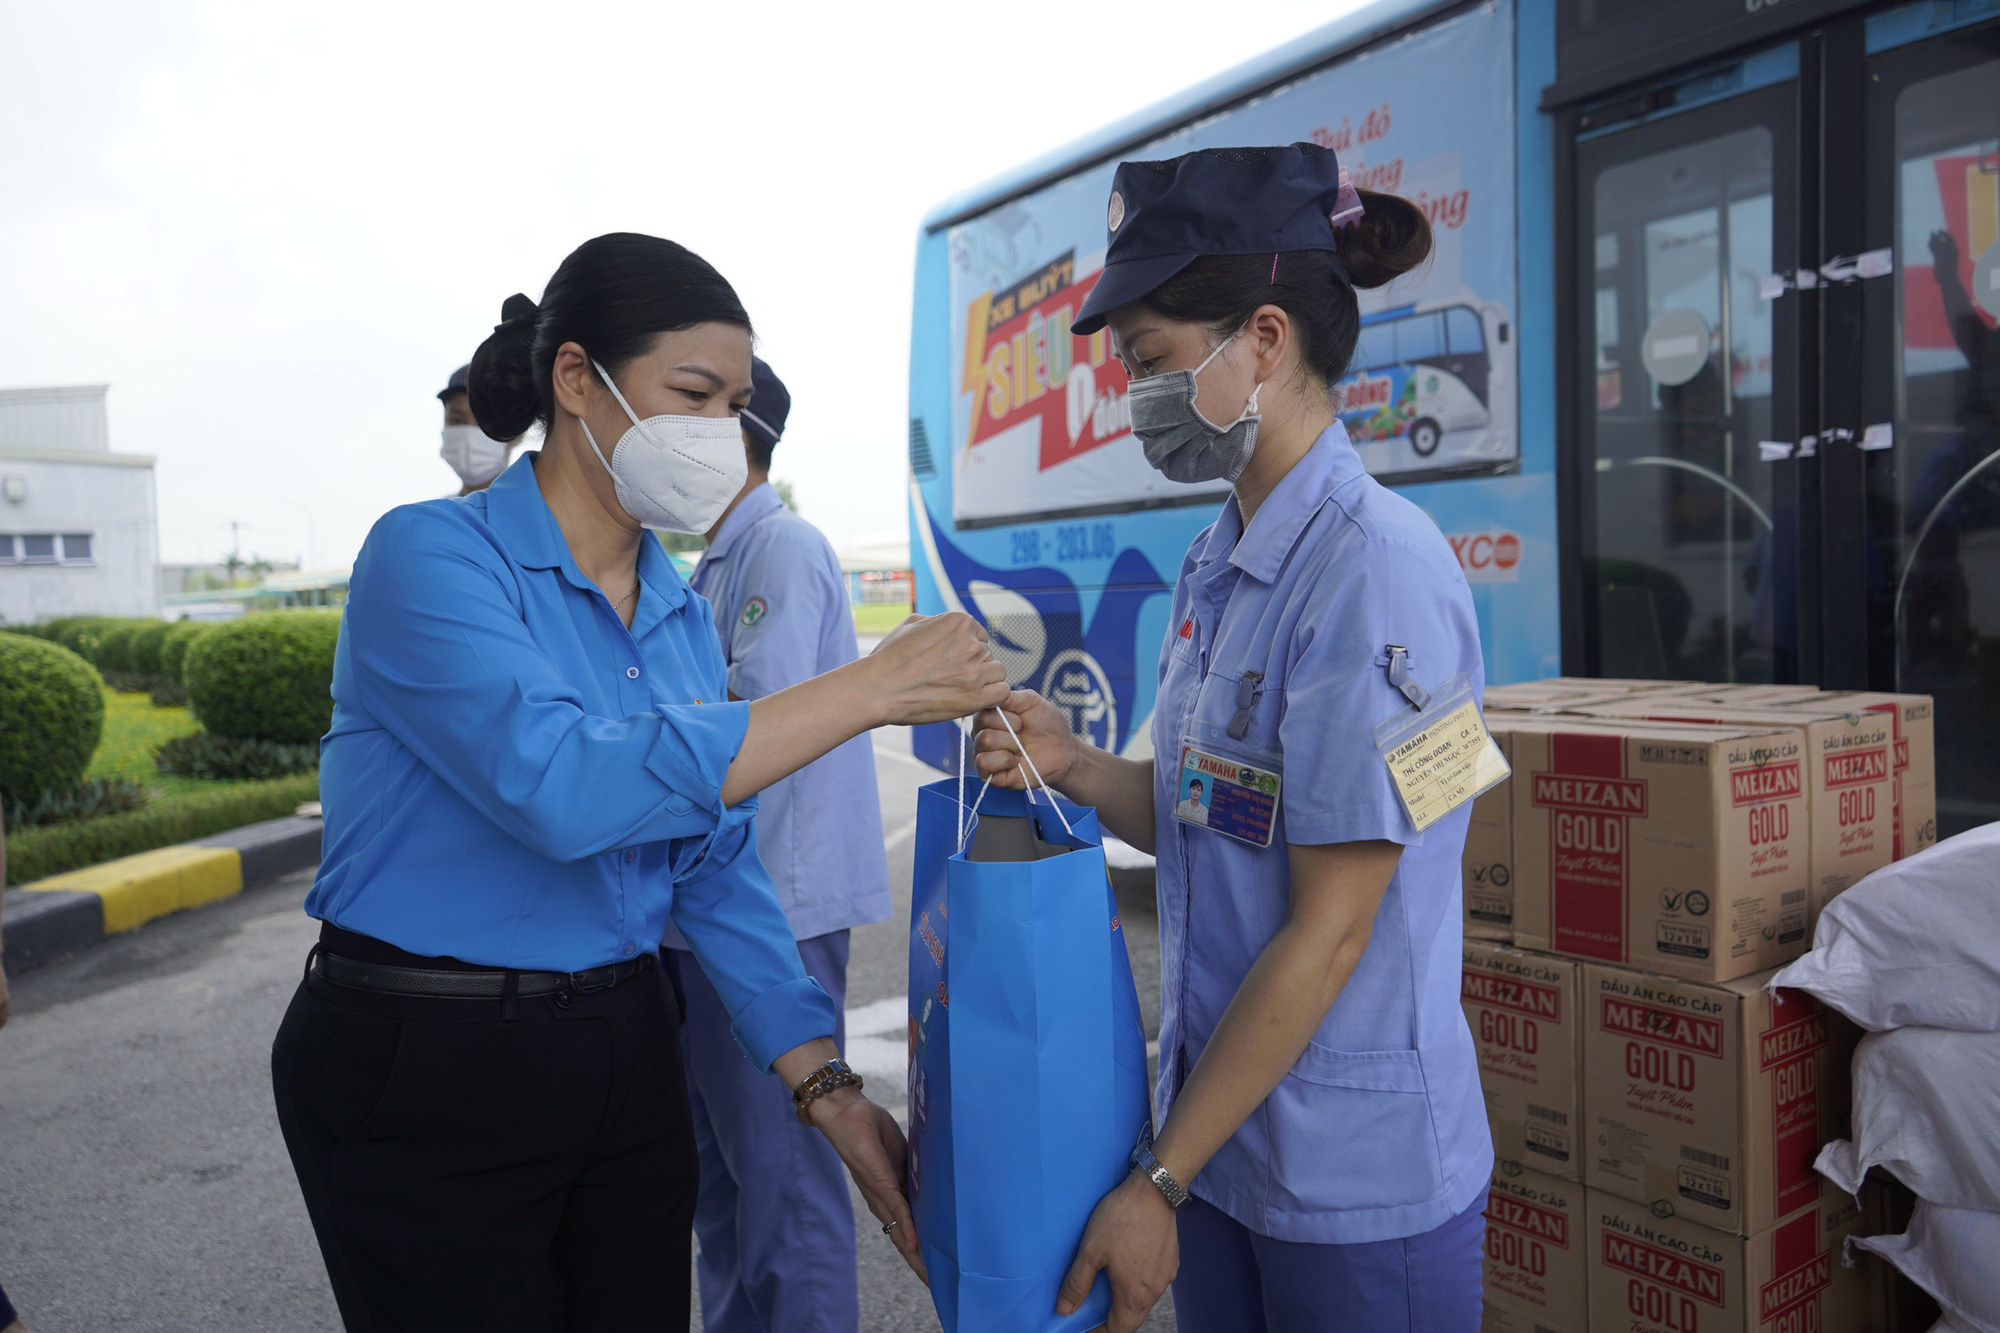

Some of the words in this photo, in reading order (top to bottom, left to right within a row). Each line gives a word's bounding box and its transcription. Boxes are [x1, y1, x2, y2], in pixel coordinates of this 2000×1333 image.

[988, 306, 1073, 420] SIÊU
[672, 484, 689, 500] KN95
[1395, 733, 1428, 758] YAMAHA
[1415, 751, 1434, 770] CÔNG
[1433, 740, 1452, 759] ĐOẠN
[1460, 729, 1470, 739] CA
[1198, 757, 1237, 781] YAMAHA
[1734, 768, 1798, 799] MEIZAN
[1828, 752, 1885, 783] MEIZAN
[1408, 792, 1426, 807] Model
[1537, 779, 1642, 810] MEIZAN
[1839, 787, 1875, 827] GOLD
[1557, 813, 1621, 855] GOLD
[1749, 803, 1789, 846] GOLD
[1663, 931, 1676, 942] 12
[1506, 963, 1531, 977] CAO
[1464, 974, 1556, 1016] MEIZAN
[1657, 991, 1687, 1007] CAO
[1480, 1009, 1538, 1055] GOLD
[1606, 1003, 1717, 1050] MEIZAN
[1763, 1020, 1826, 1063] MEIZAN
[1625, 1041, 1696, 1093] GOLD
[1777, 1057, 1816, 1106] GOLD
[1511, 1184, 1537, 1200] CAO
[1489, 1195, 1564, 1242] EIZAN
[1488, 1226, 1546, 1277] GOLD
[1658, 1234, 1687, 1252] CAO
[1608, 1239, 1719, 1300] MEIZAN
[1763, 1258, 1828, 1314] MEIZAN
[1628, 1279, 1697, 1333] GOLD
